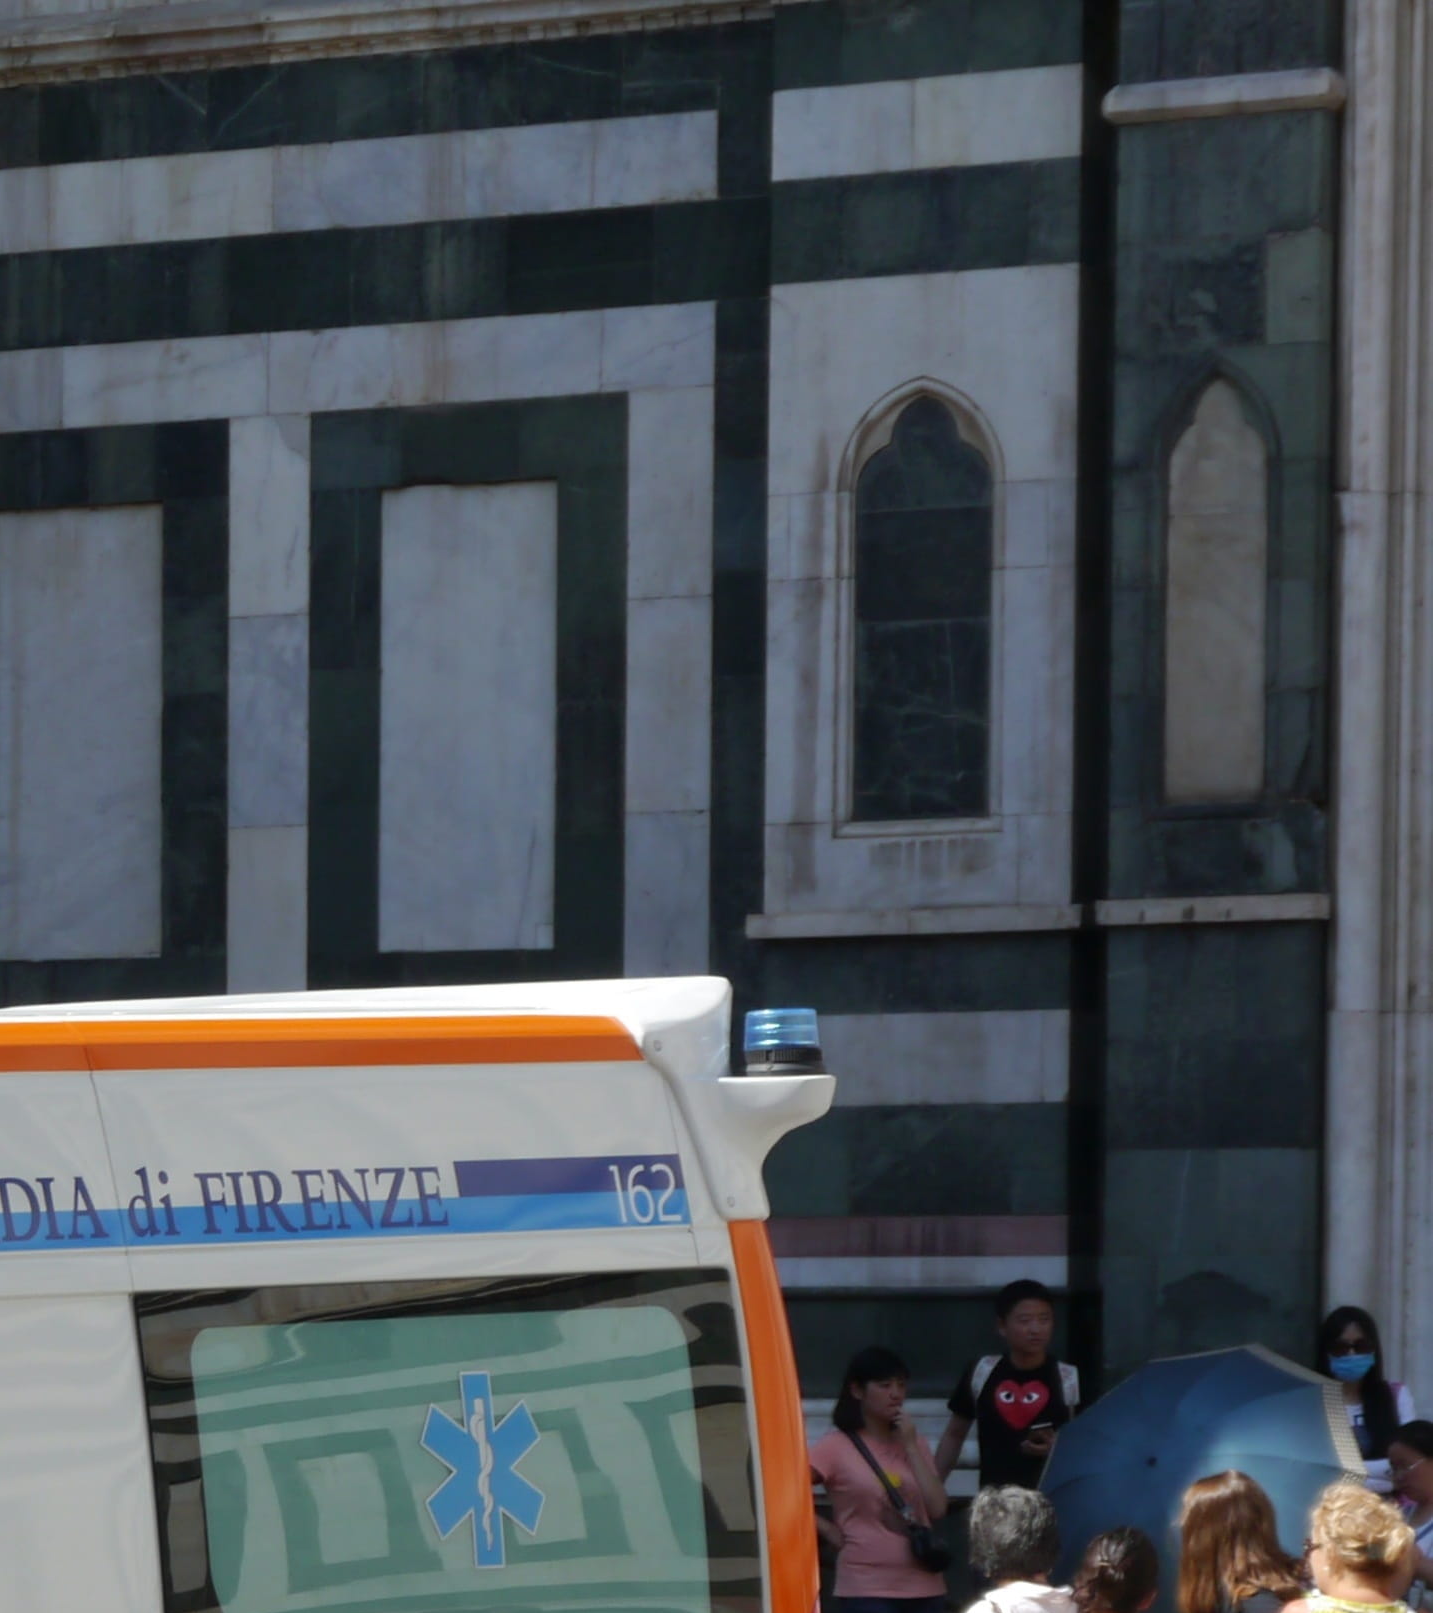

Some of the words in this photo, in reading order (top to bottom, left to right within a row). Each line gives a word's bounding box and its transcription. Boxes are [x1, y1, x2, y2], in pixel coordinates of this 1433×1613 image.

[125, 1166, 181, 1238] di
[193, 1166, 451, 1235] FIRENZE
[608, 1163, 684, 1225] 162
